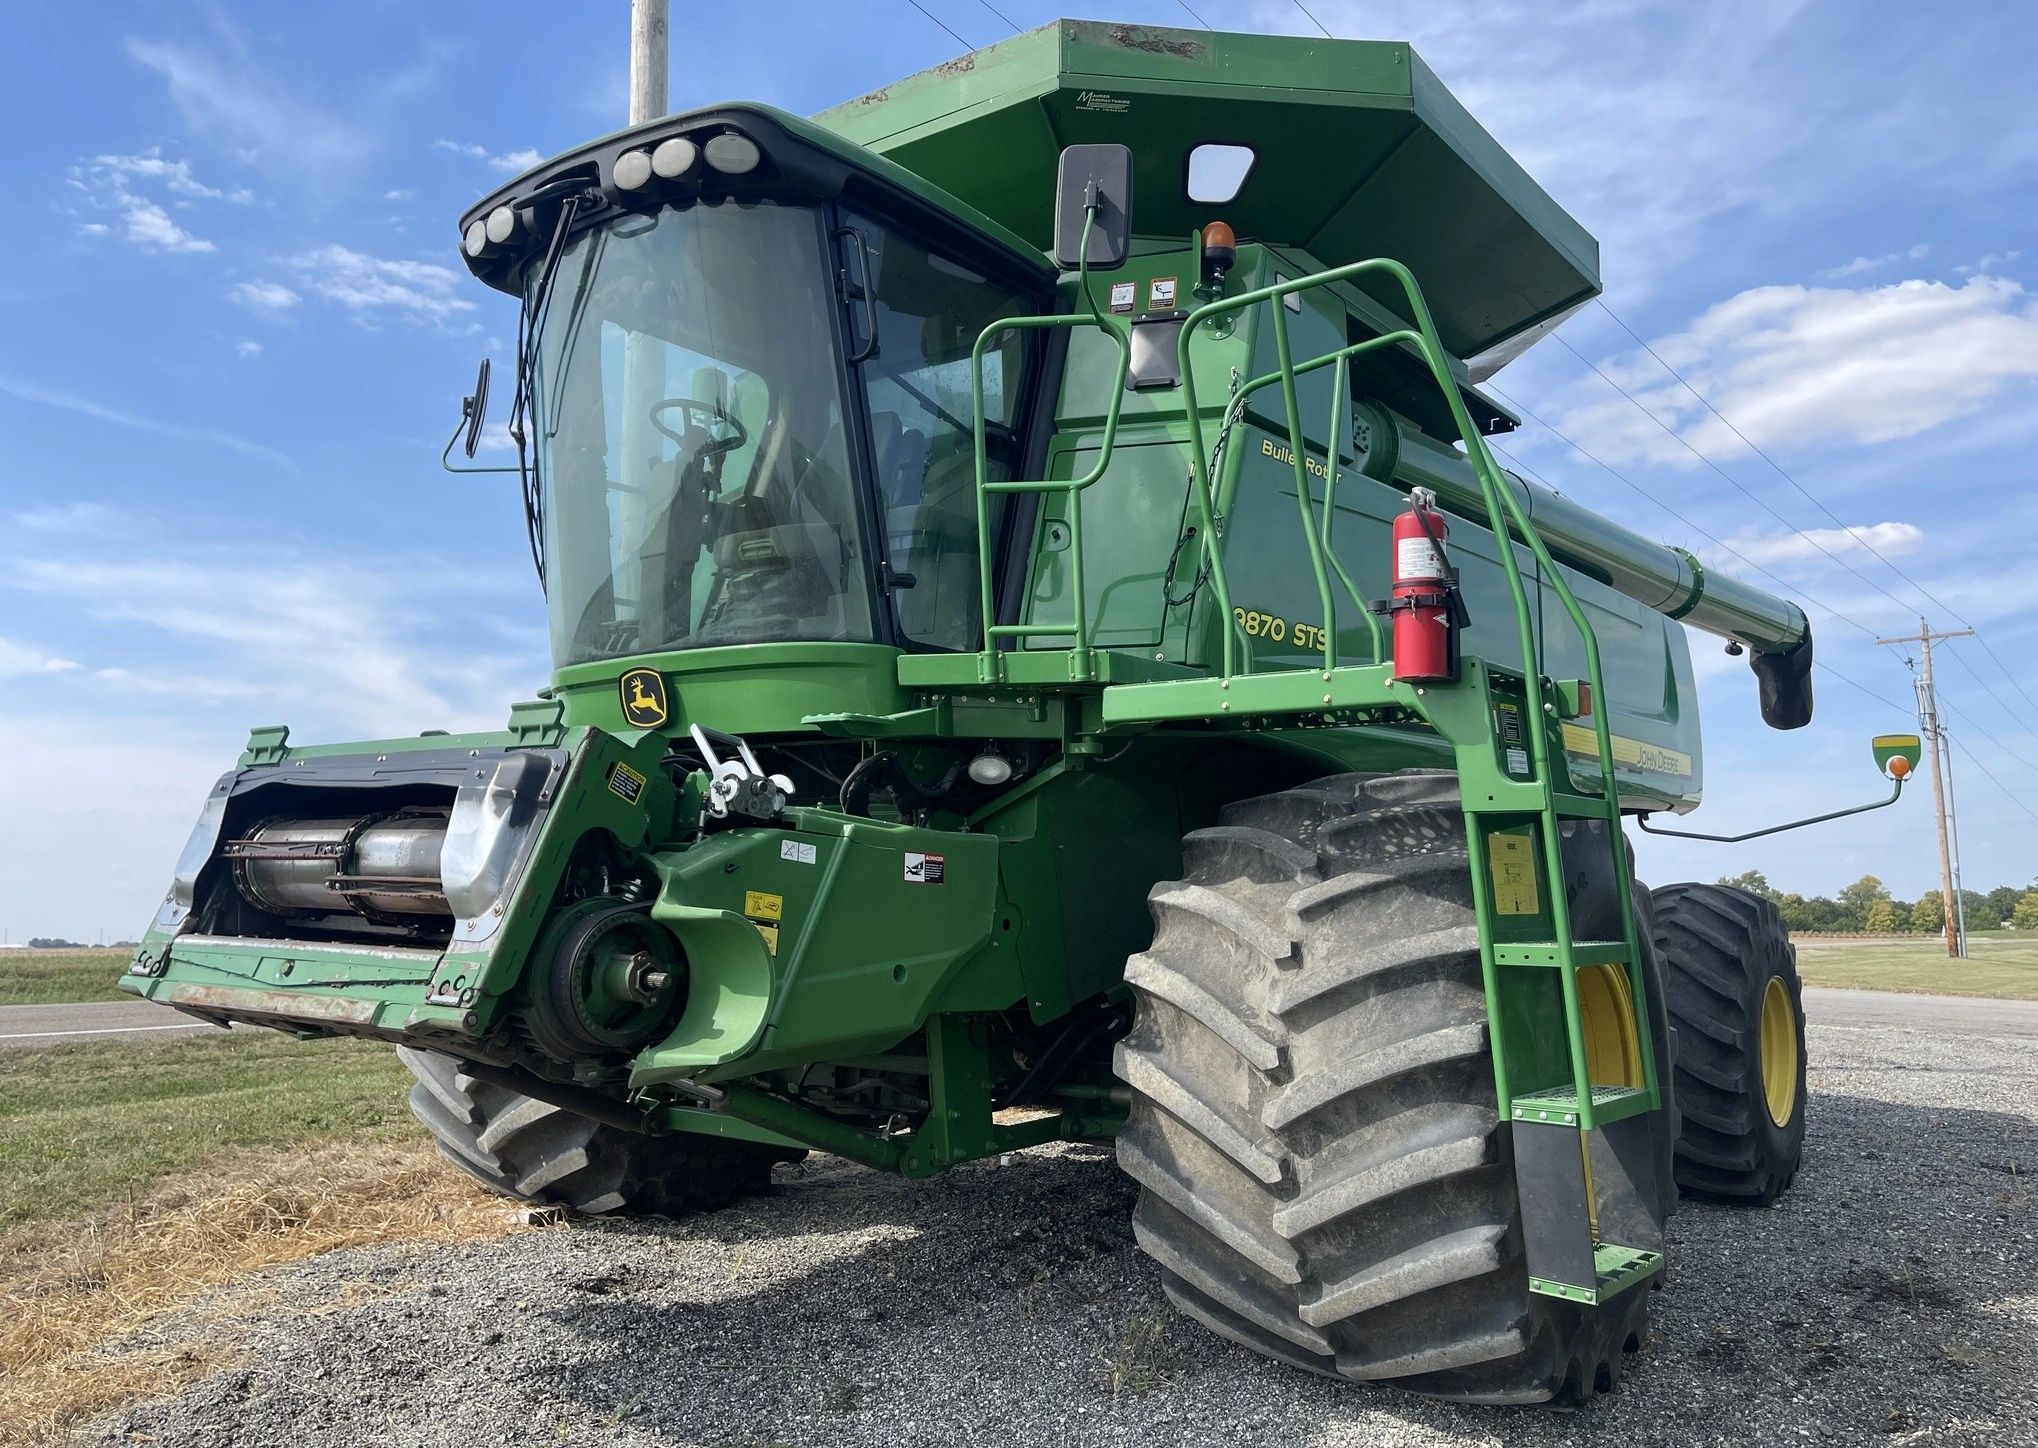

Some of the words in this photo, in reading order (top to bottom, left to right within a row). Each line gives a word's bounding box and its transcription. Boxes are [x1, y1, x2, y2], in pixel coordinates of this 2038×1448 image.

[1261, 439, 1295, 466] Bulle
[1305, 456, 1342, 483] Rotr
[1233, 606, 1286, 642] 9870
[1293, 622, 1325, 652] STS
[622, 765, 645, 784] CAUTION
[1637, 745, 1659, 770] JOHN
[1657, 750, 1680, 775] DEERE
